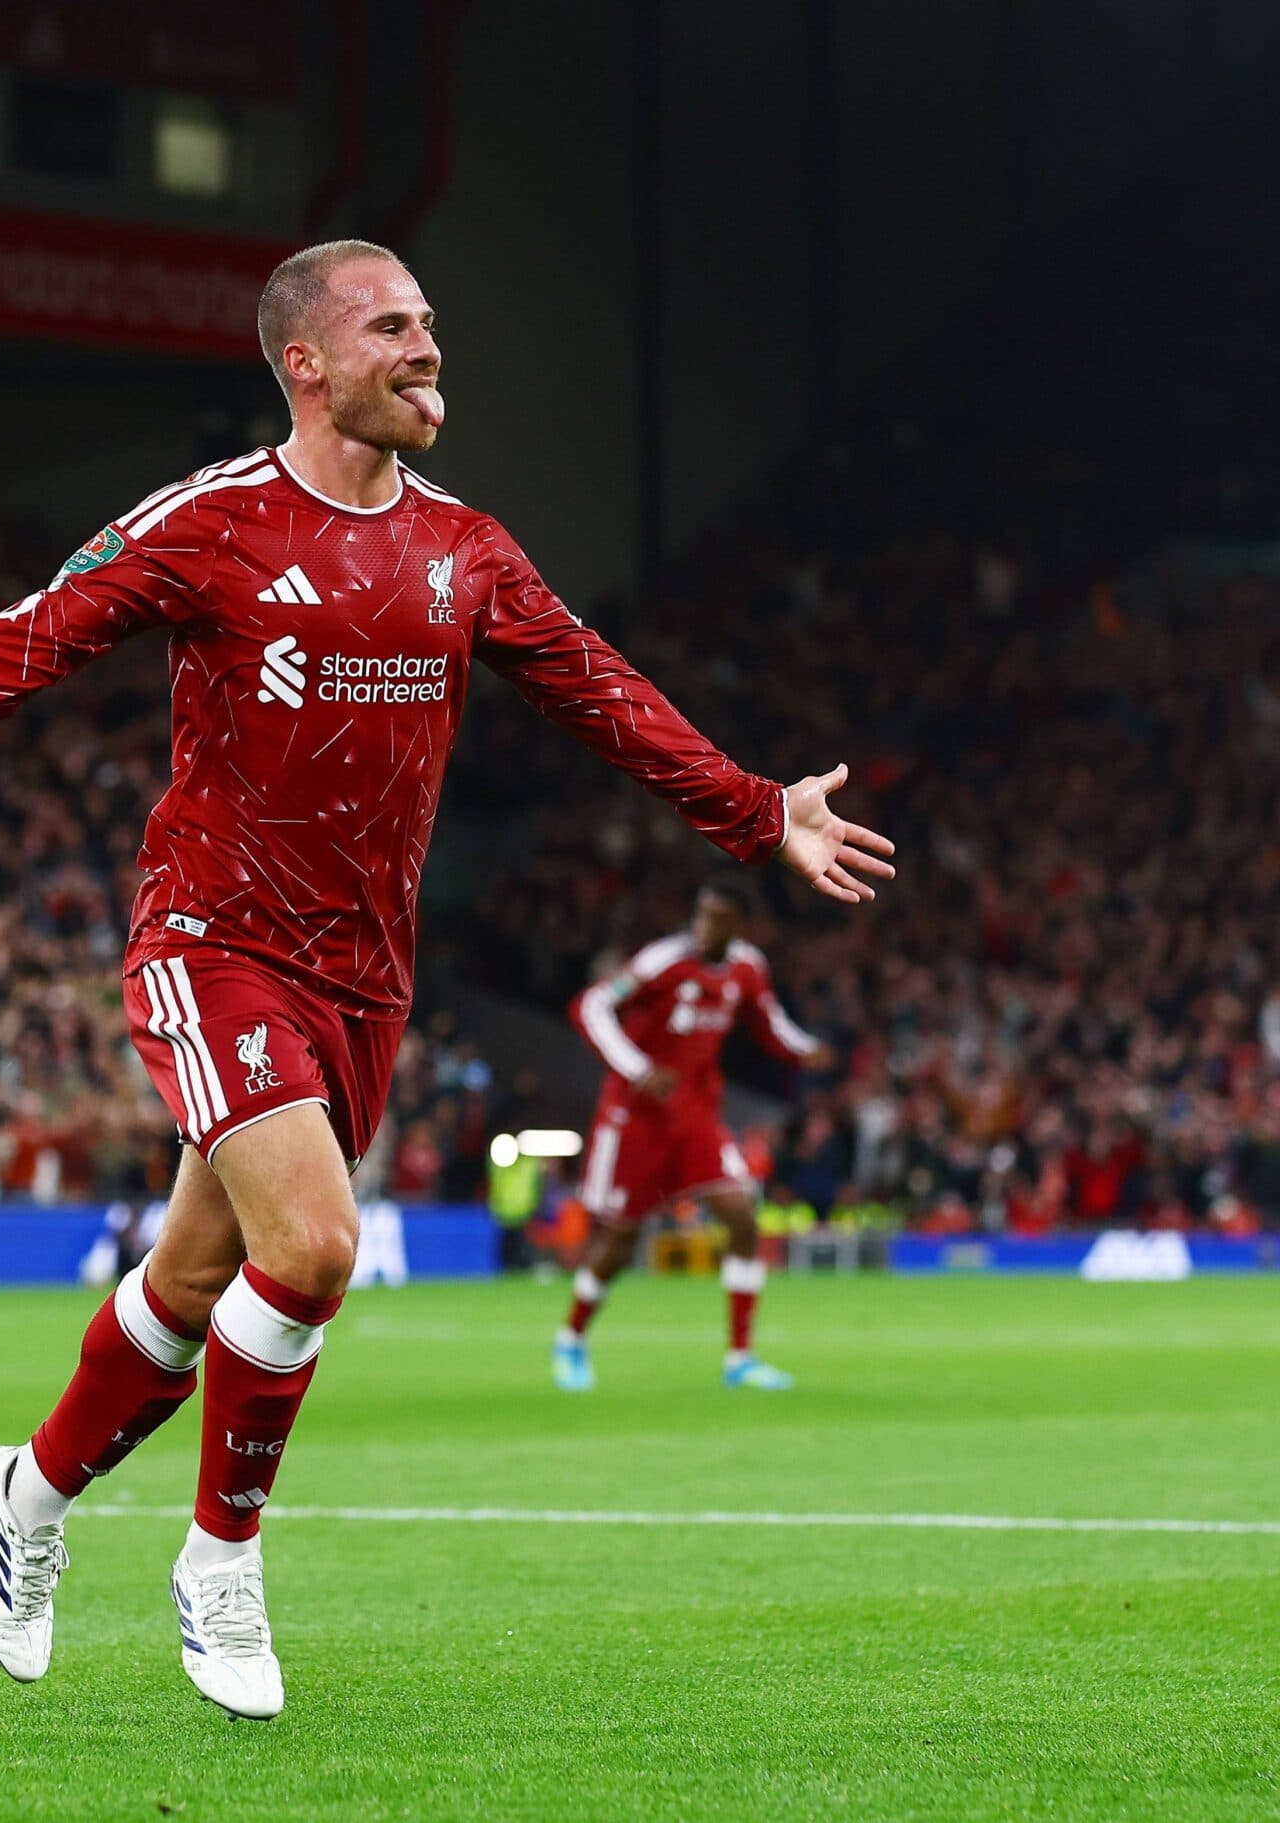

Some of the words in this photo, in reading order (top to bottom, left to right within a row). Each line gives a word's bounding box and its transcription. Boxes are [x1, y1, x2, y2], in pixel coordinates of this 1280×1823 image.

[320, 652, 448, 679] standard
[318, 677, 447, 703] chartered
[225, 1430, 283, 1457] LFC
